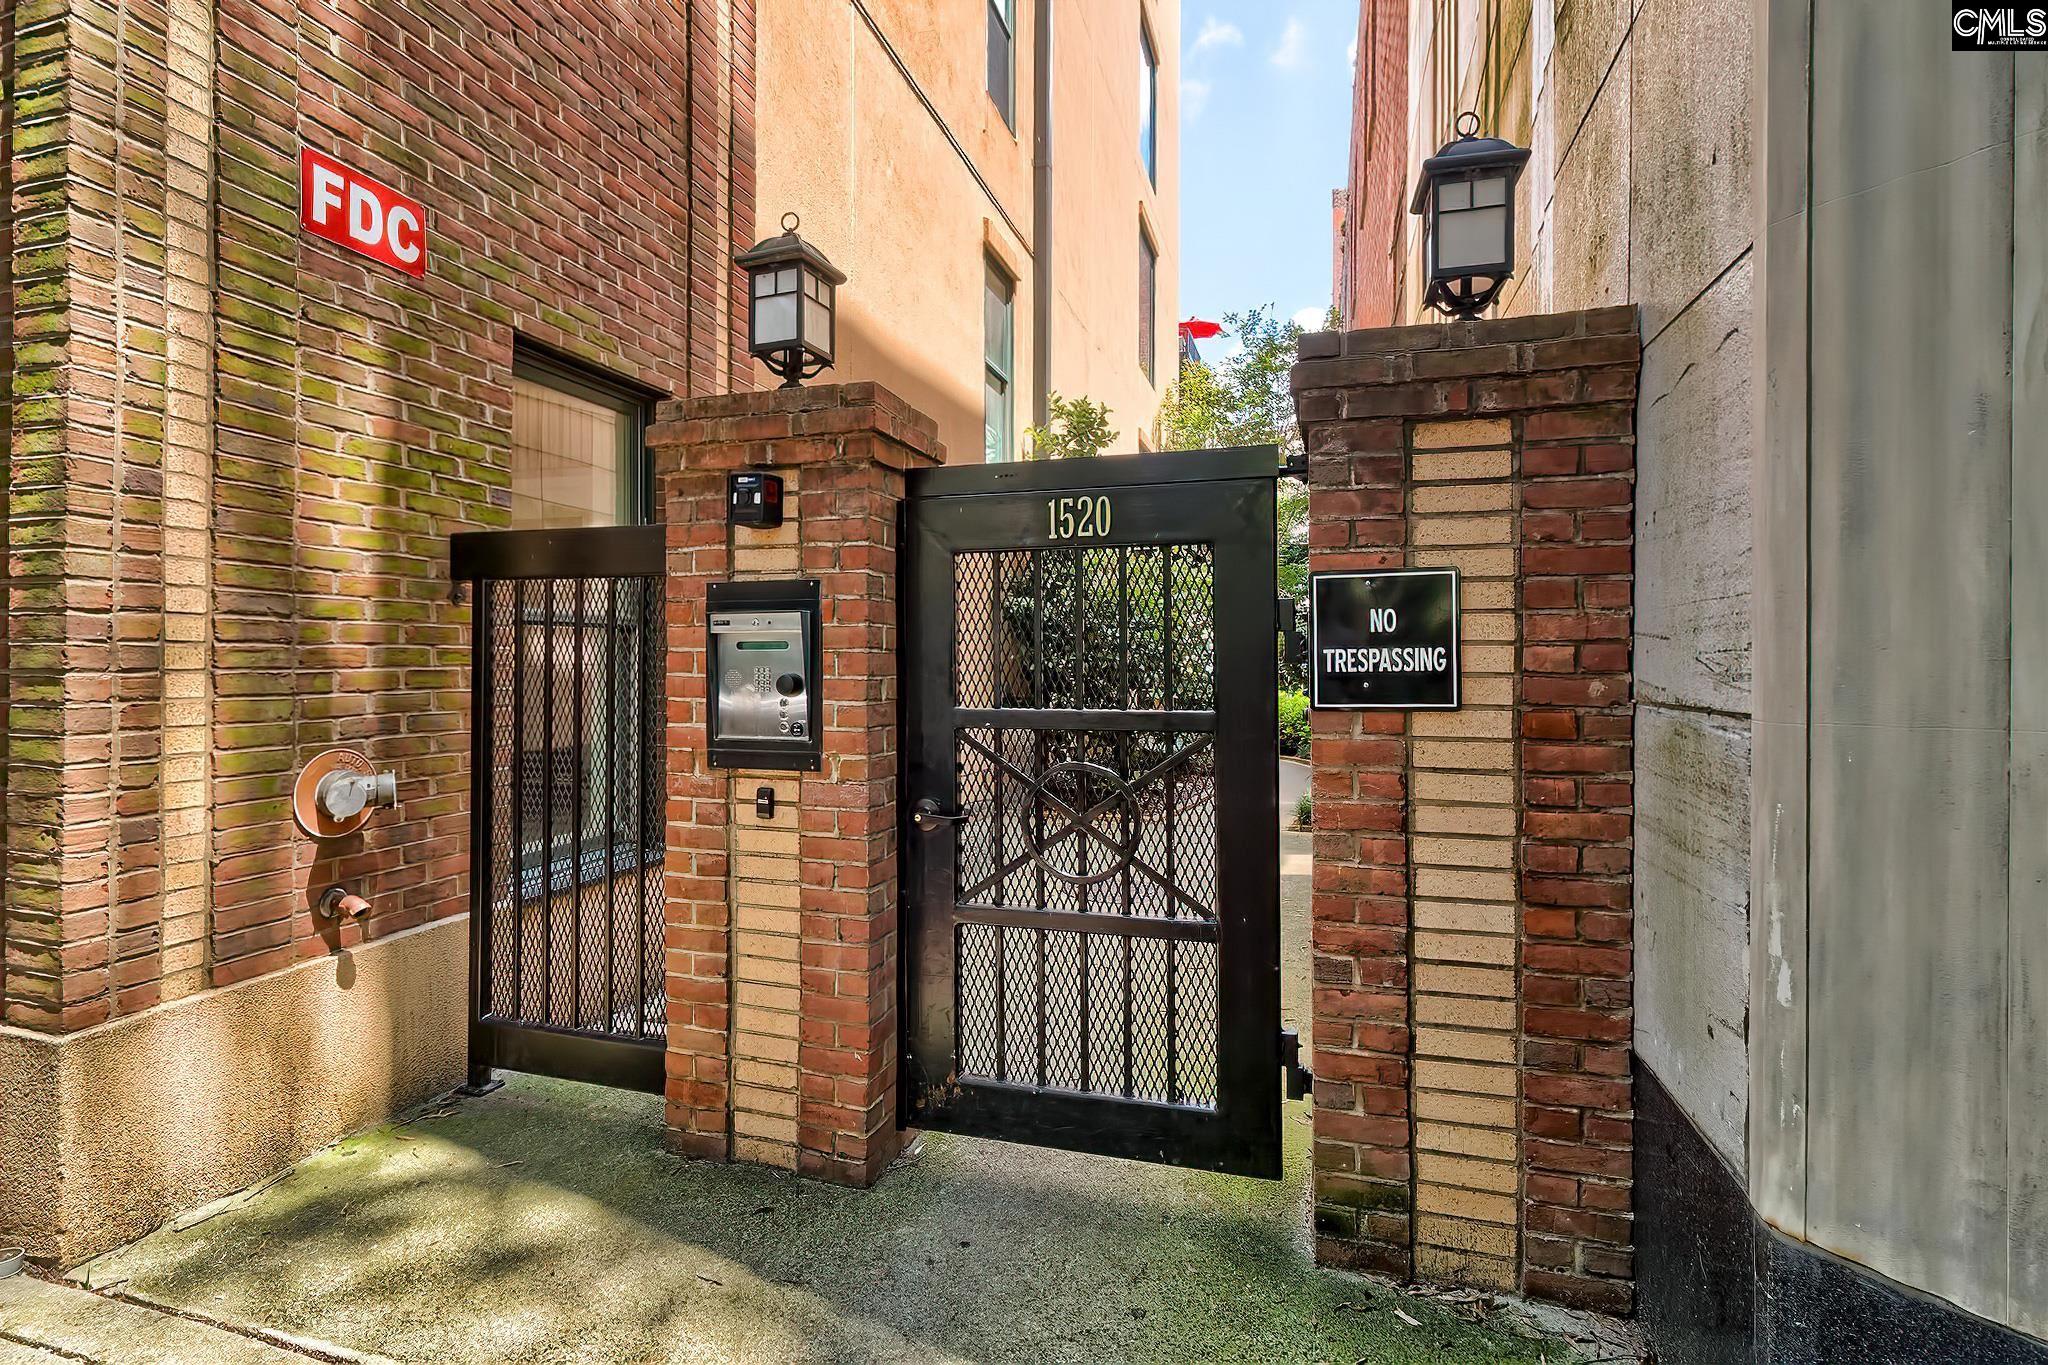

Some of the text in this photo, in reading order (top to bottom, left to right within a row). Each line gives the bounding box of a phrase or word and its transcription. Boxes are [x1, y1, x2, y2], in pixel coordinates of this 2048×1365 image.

[312, 163, 420, 263] FDC
[1048, 495, 1111, 539] 1520
[1370, 608, 1397, 633] NO
[1322, 647, 1447, 673] TRESPASSING
